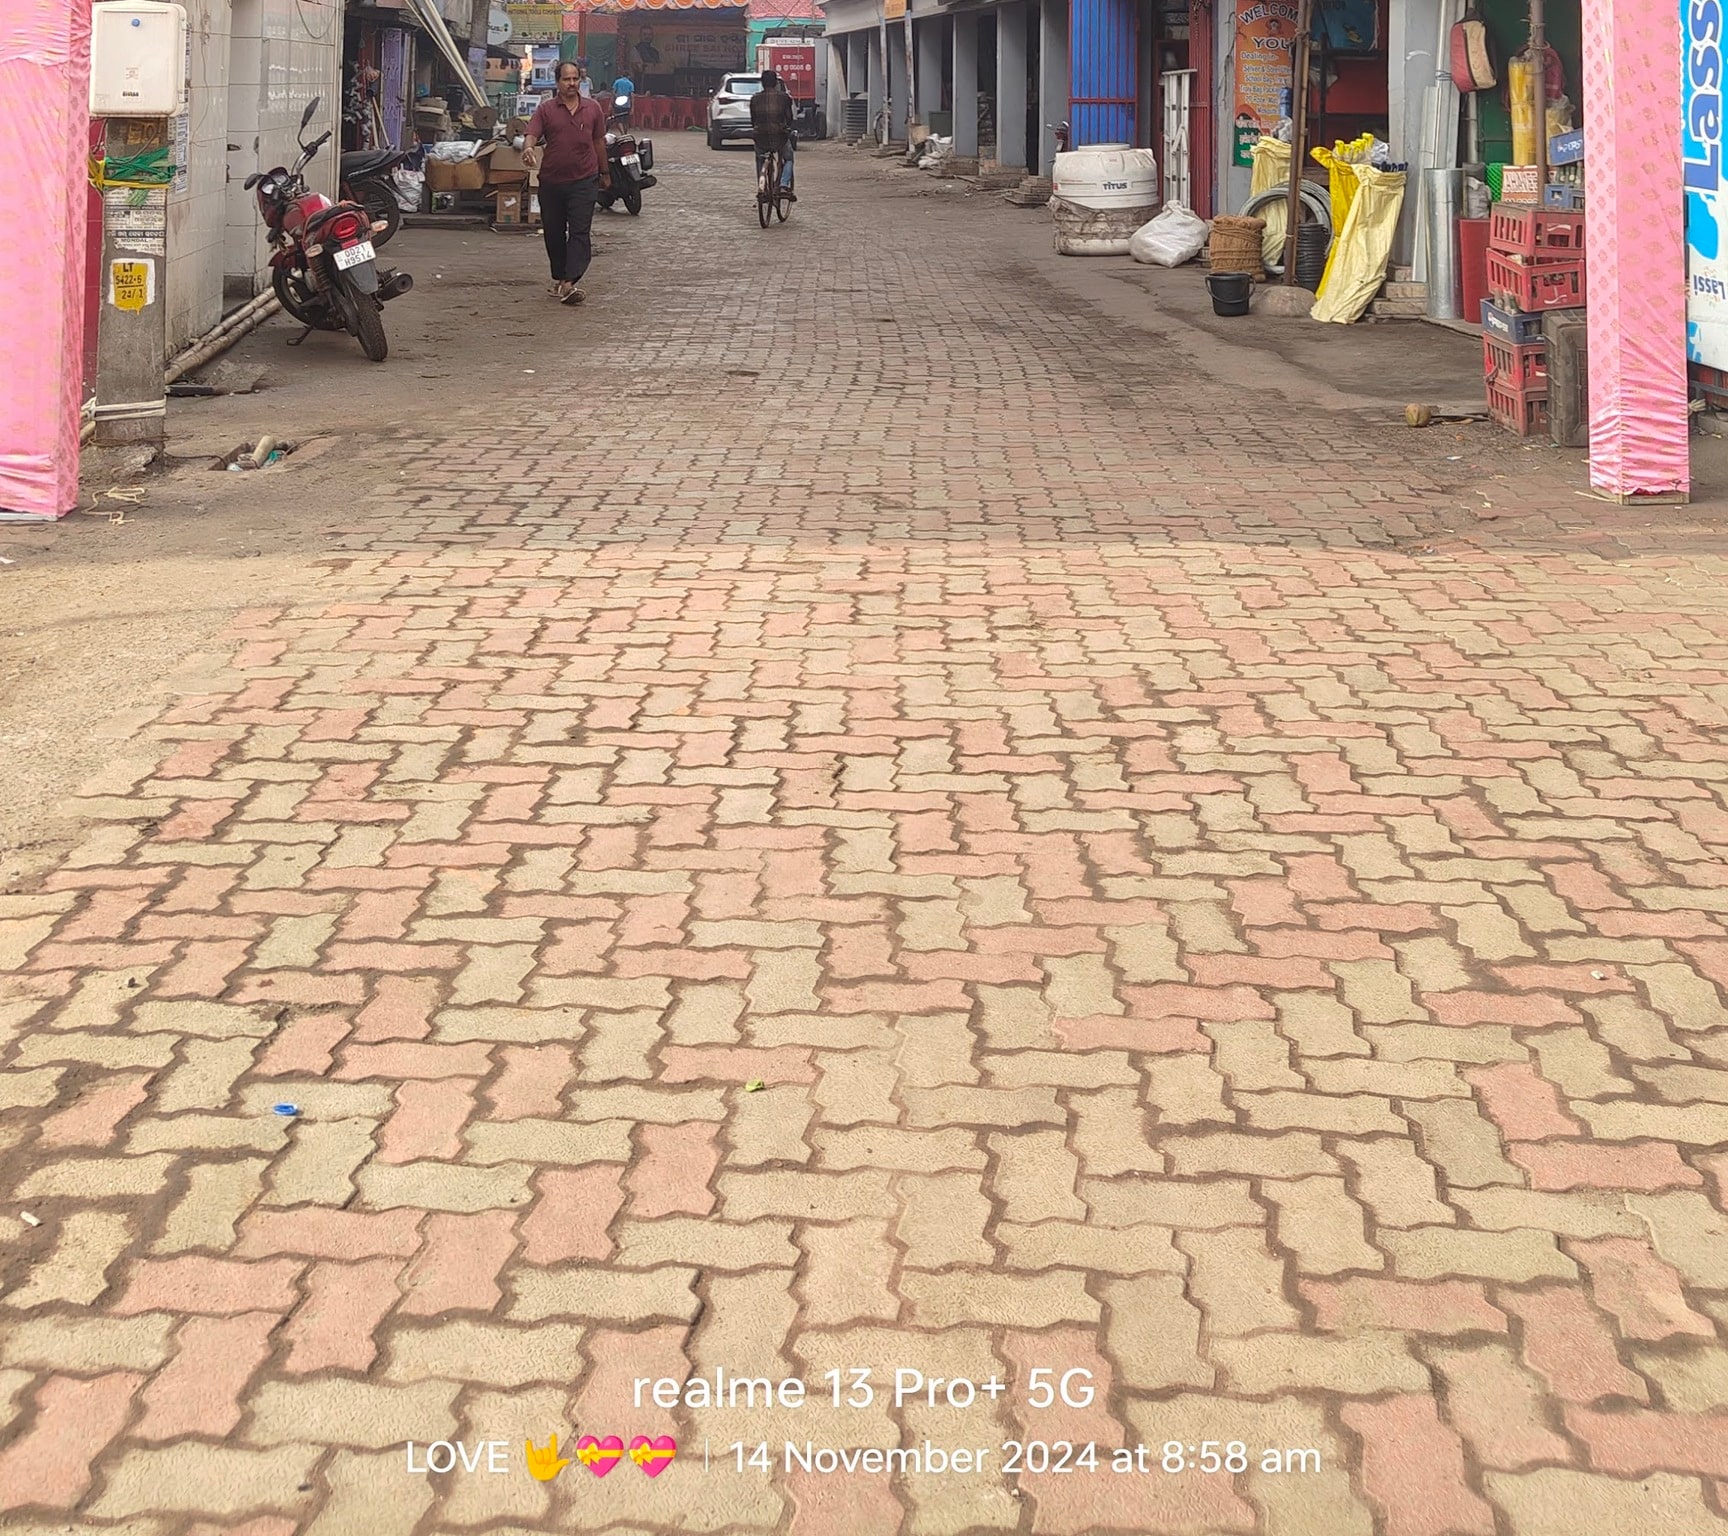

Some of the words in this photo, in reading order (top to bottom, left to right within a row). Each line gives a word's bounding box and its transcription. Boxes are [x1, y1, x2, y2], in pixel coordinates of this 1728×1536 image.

[1239, 3, 1299, 25] WELCOM
[123, 262, 134, 272] LT
[1693, 274, 1726, 300] Lassi
